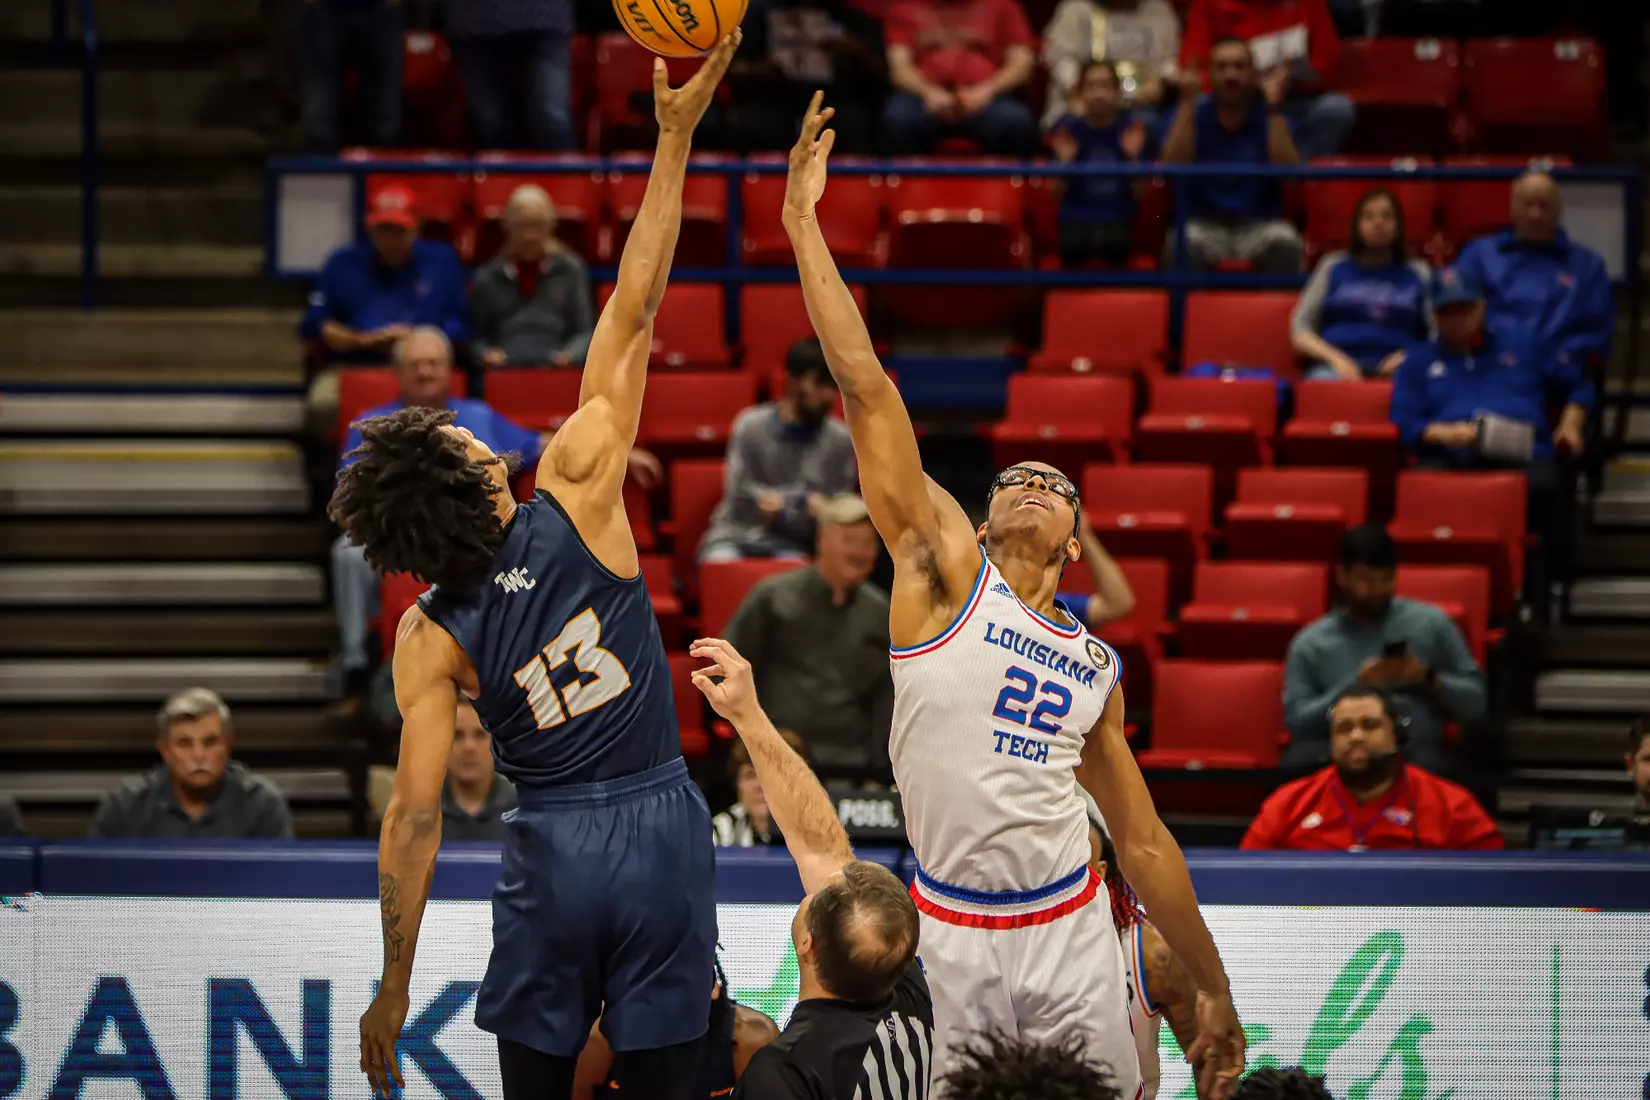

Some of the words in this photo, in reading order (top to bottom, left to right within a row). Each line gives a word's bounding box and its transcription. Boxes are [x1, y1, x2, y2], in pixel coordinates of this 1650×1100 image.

[494, 566, 536, 594] TWC
[512, 606, 632, 731] 13
[983, 621, 1098, 690] LOUISIANA
[992, 664, 1073, 737] 22
[993, 729, 1049, 765] TECH
